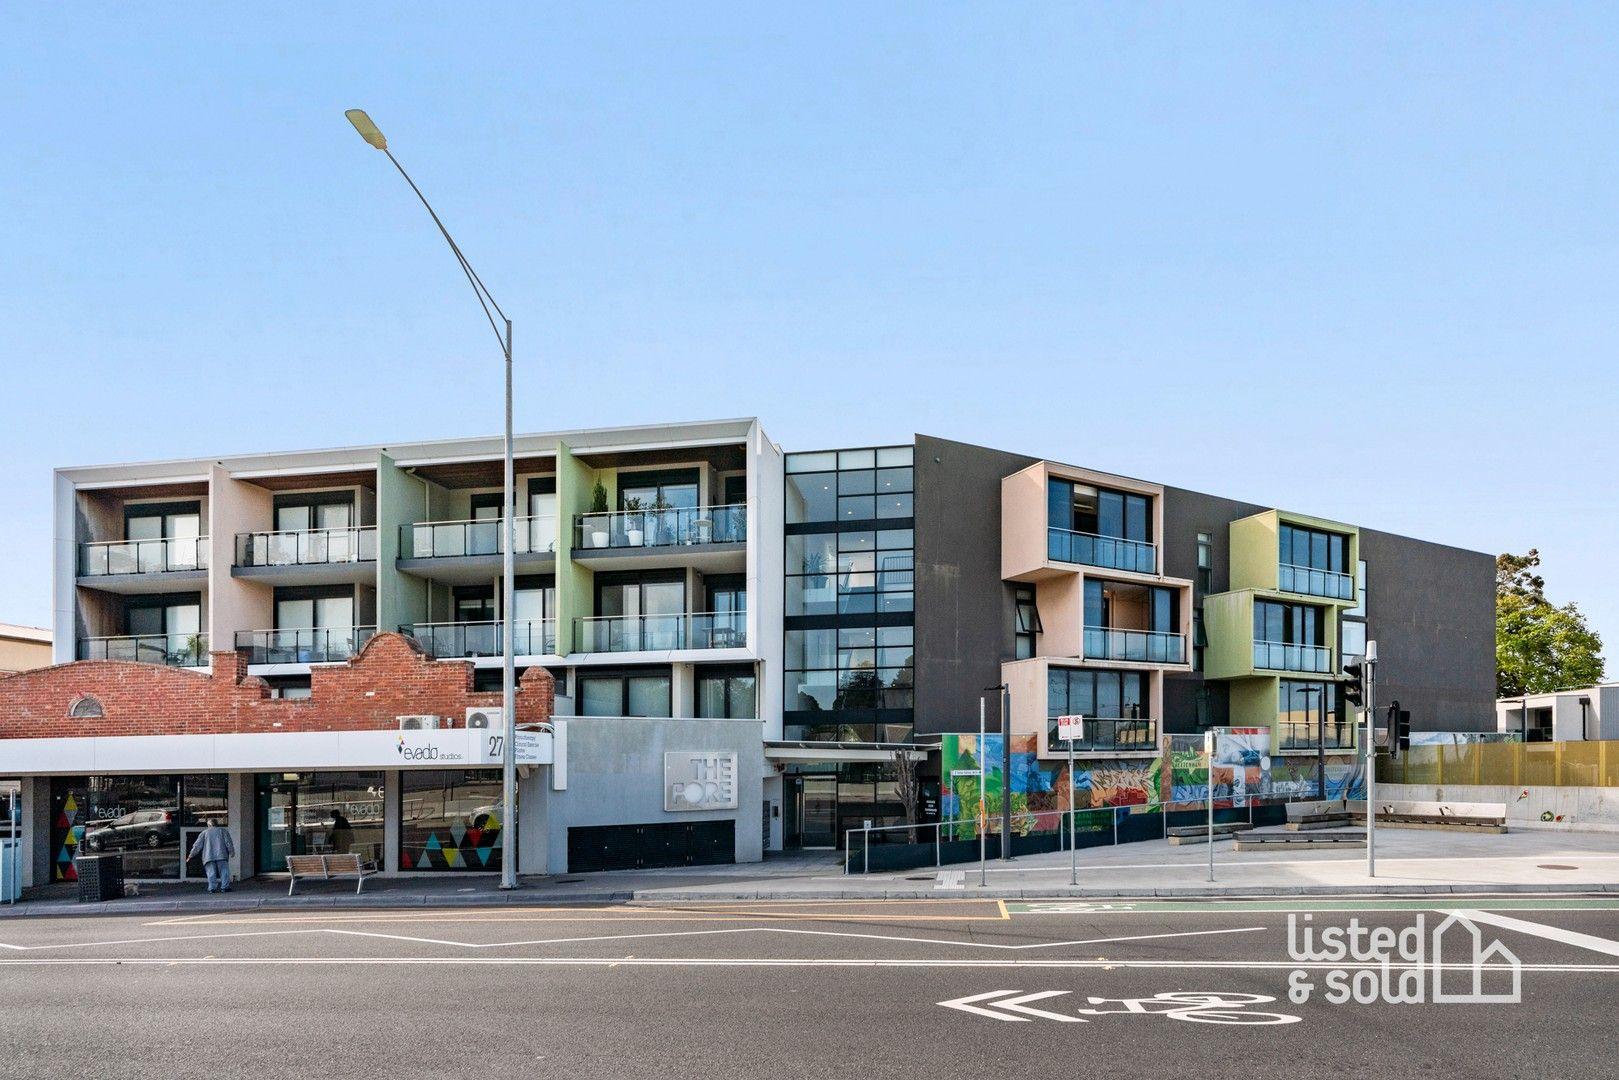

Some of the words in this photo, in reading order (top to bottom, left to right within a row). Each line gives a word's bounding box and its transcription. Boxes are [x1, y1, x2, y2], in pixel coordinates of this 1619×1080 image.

[489, 736, 503, 756] 27
[690, 758, 731, 780] THE
[672, 780, 731, 804] FORE
